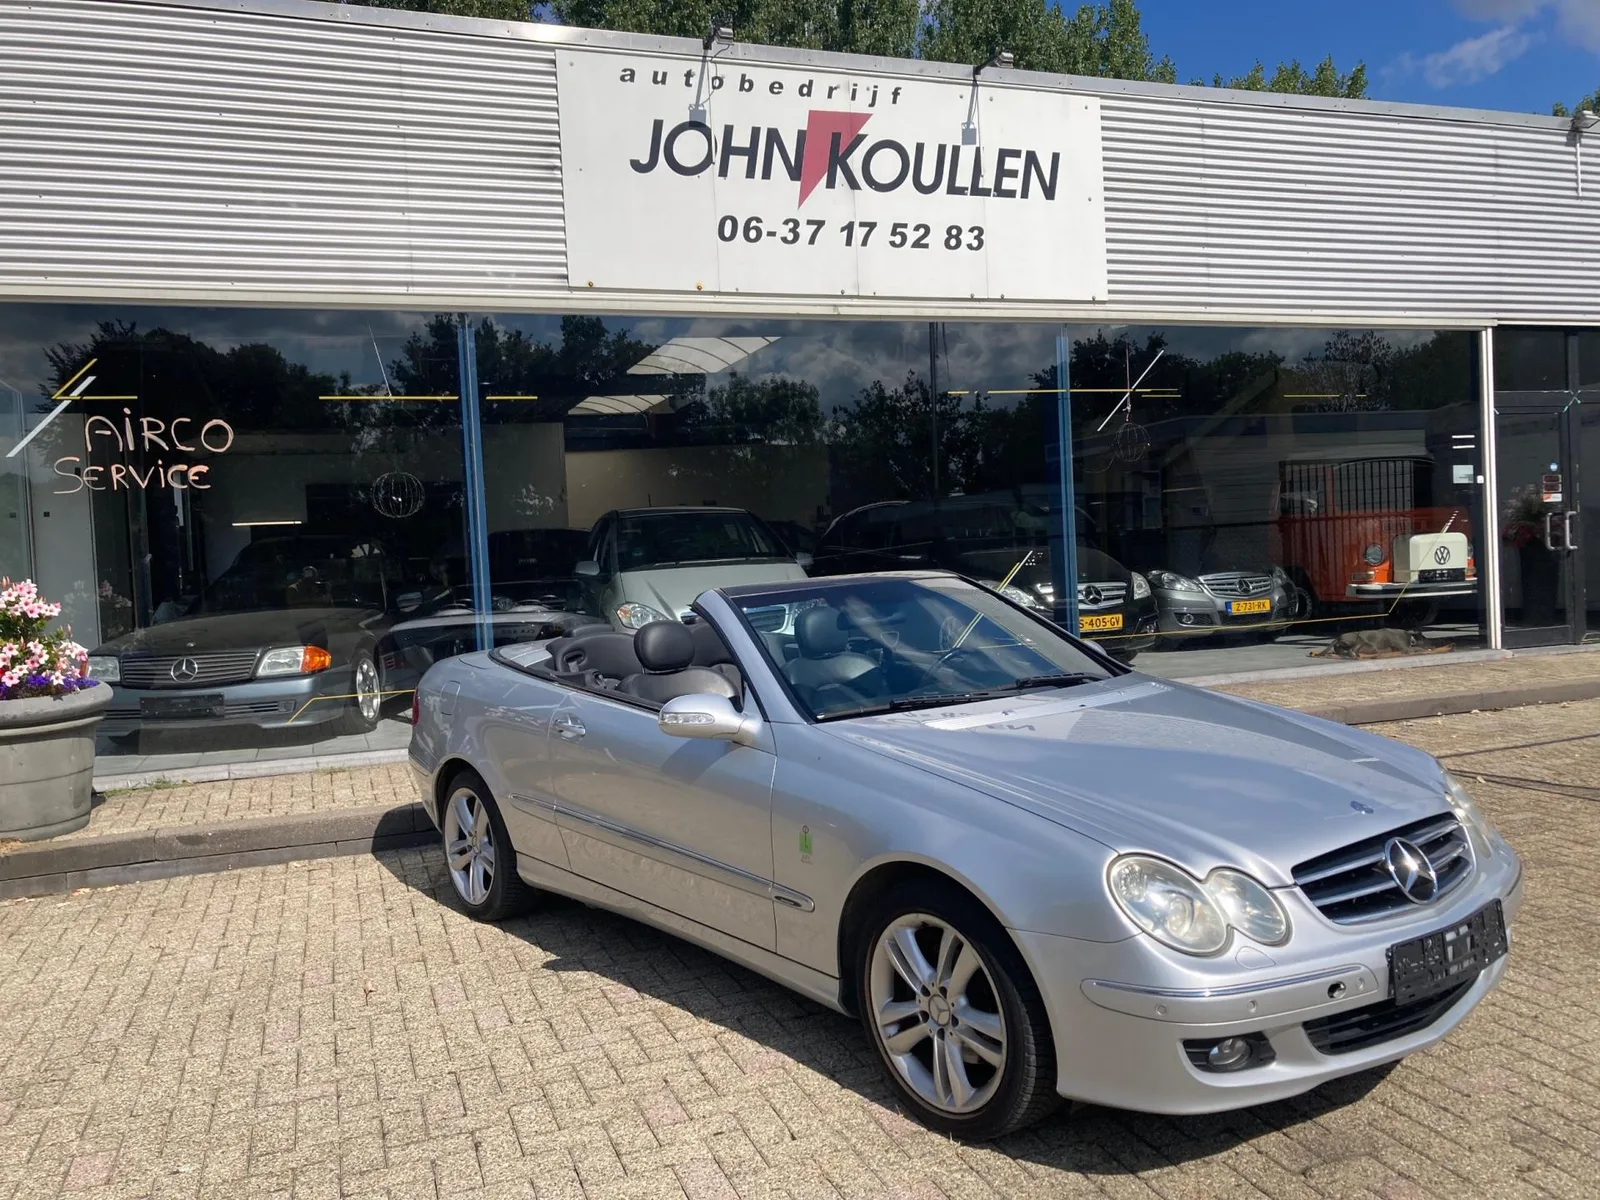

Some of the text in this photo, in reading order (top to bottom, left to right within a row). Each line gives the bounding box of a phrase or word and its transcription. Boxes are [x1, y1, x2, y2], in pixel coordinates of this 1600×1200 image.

[619, 67, 902, 108] autobedrijf
[629, 118, 1061, 201] JOHN KOULLEN
[717, 214, 985, 252] 06-37 17 52 83
